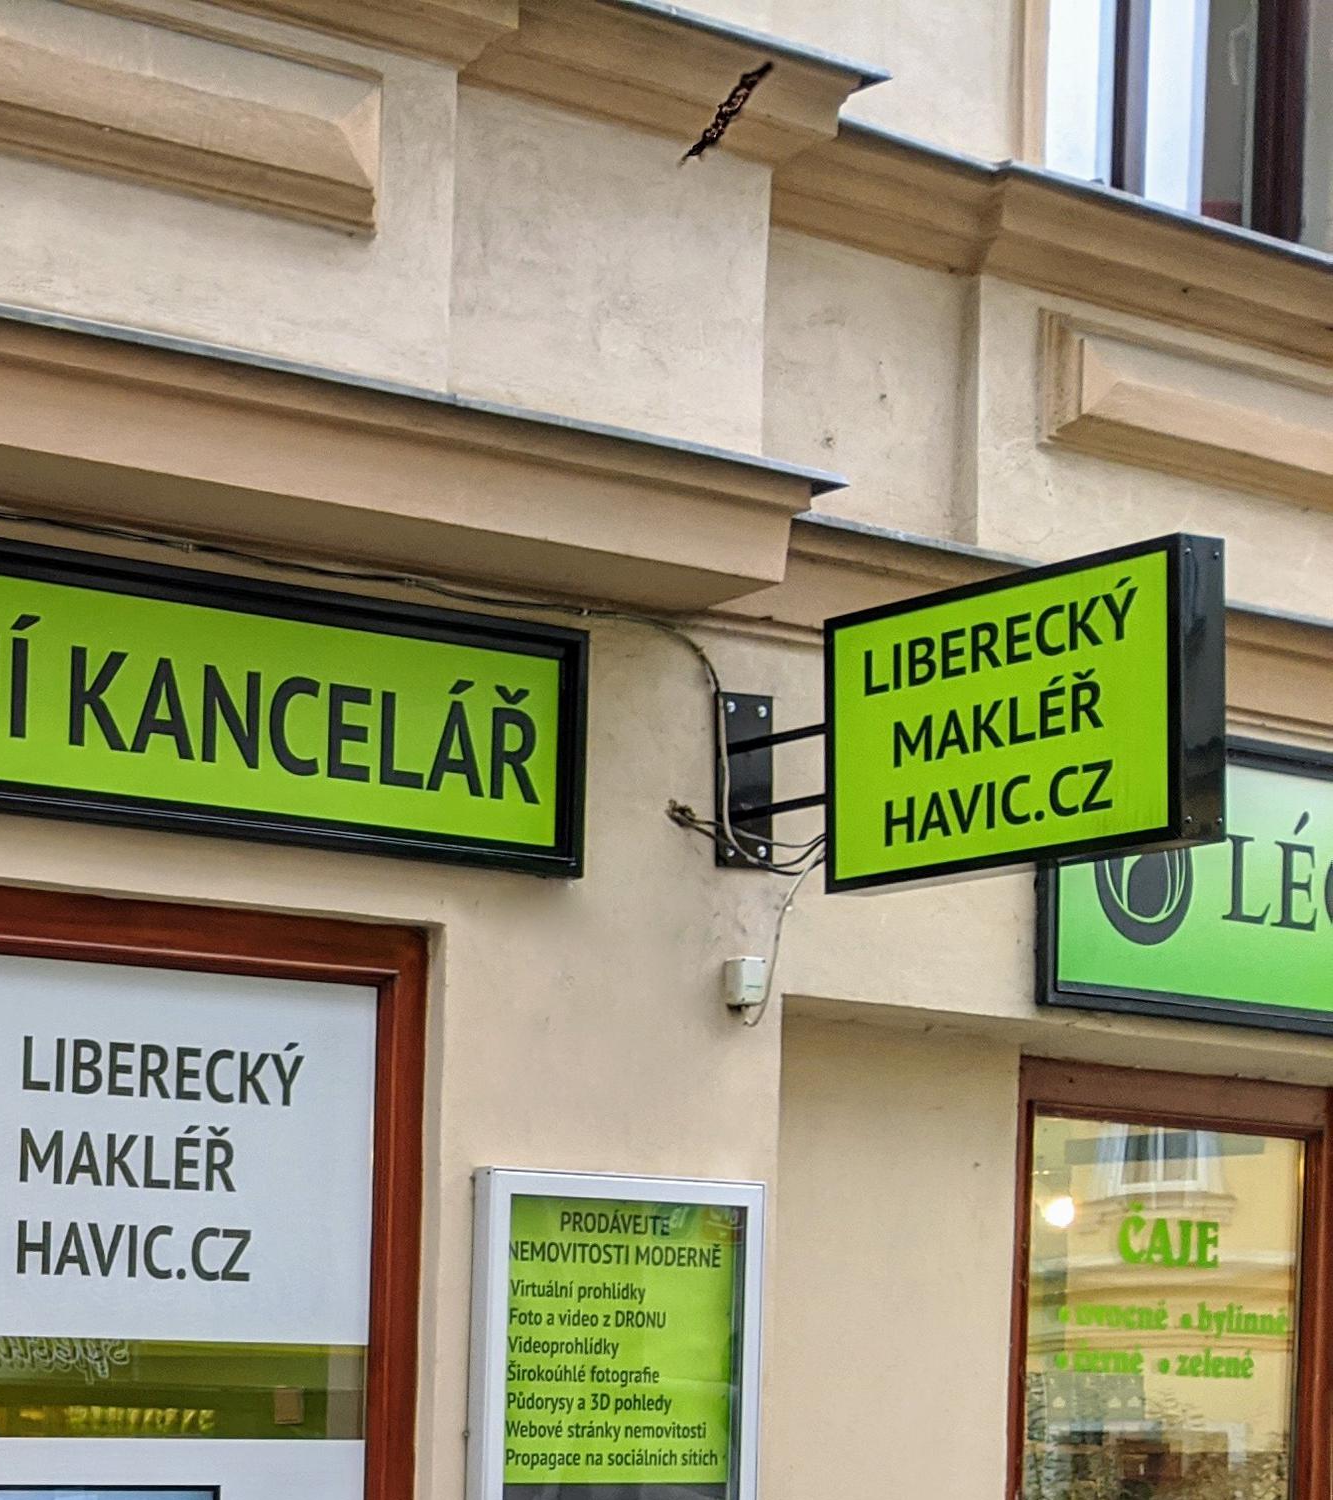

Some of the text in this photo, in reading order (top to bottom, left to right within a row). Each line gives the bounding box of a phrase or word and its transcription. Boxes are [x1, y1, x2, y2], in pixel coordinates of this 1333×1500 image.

[864, 576, 1138, 697] LIBERECKÝ
[68, 646, 542, 805] KANCELÁŘ
[893, 668, 1104, 768] MAKLÉŘ
[884, 759, 1114, 847] HAVIC.CZ
[1222, 811, 1333, 932] LÉ
[22, 1035, 305, 1107] LIBERECKÝ
[19, 1124, 237, 1192] MAKLÉŘ
[560, 1209, 670, 1235] PRODÁVEJTE
[1119, 1201, 1219, 1268] ČAJE
[16, 1220, 252, 1282] HAVIC.CZ
[509, 1241, 721, 1268] NEMOVITOSTI MODERNĚ
[511, 1279, 573, 1298] Virtuální
[510, 1308, 666, 1328] Foto a video z DRONU
[1197, 1302, 1289, 1338] bylinné
[508, 1336, 619, 1358] Videoprohlídky
[1176, 1347, 1254, 1379] zelené
[507, 1360, 660, 1387] Širokoúhlé fotografie
[507, 1392, 672, 1414] Půdorysy a 3D pohledy
[505, 1420, 706, 1442] Webové stránky nemovitosti
[505, 1449, 718, 1470] Propagace na sociálních sítích
